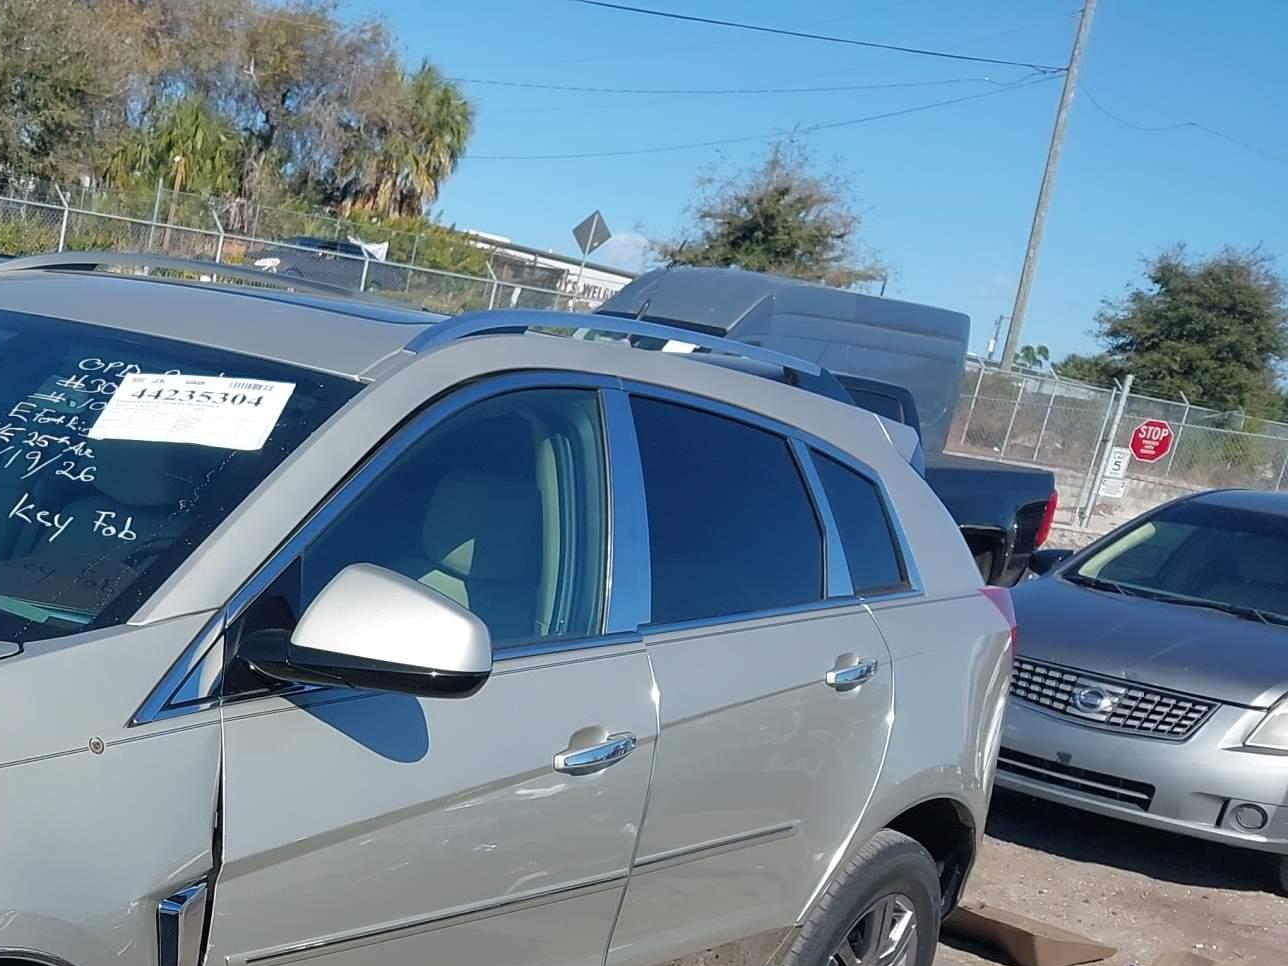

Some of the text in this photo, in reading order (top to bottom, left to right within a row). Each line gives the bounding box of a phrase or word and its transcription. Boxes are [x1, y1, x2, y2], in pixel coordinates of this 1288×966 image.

[130, 387, 265, 408] 44235304
[1138, 426, 1169, 441] STOP
[8, 493, 137, 542] Key Fob
